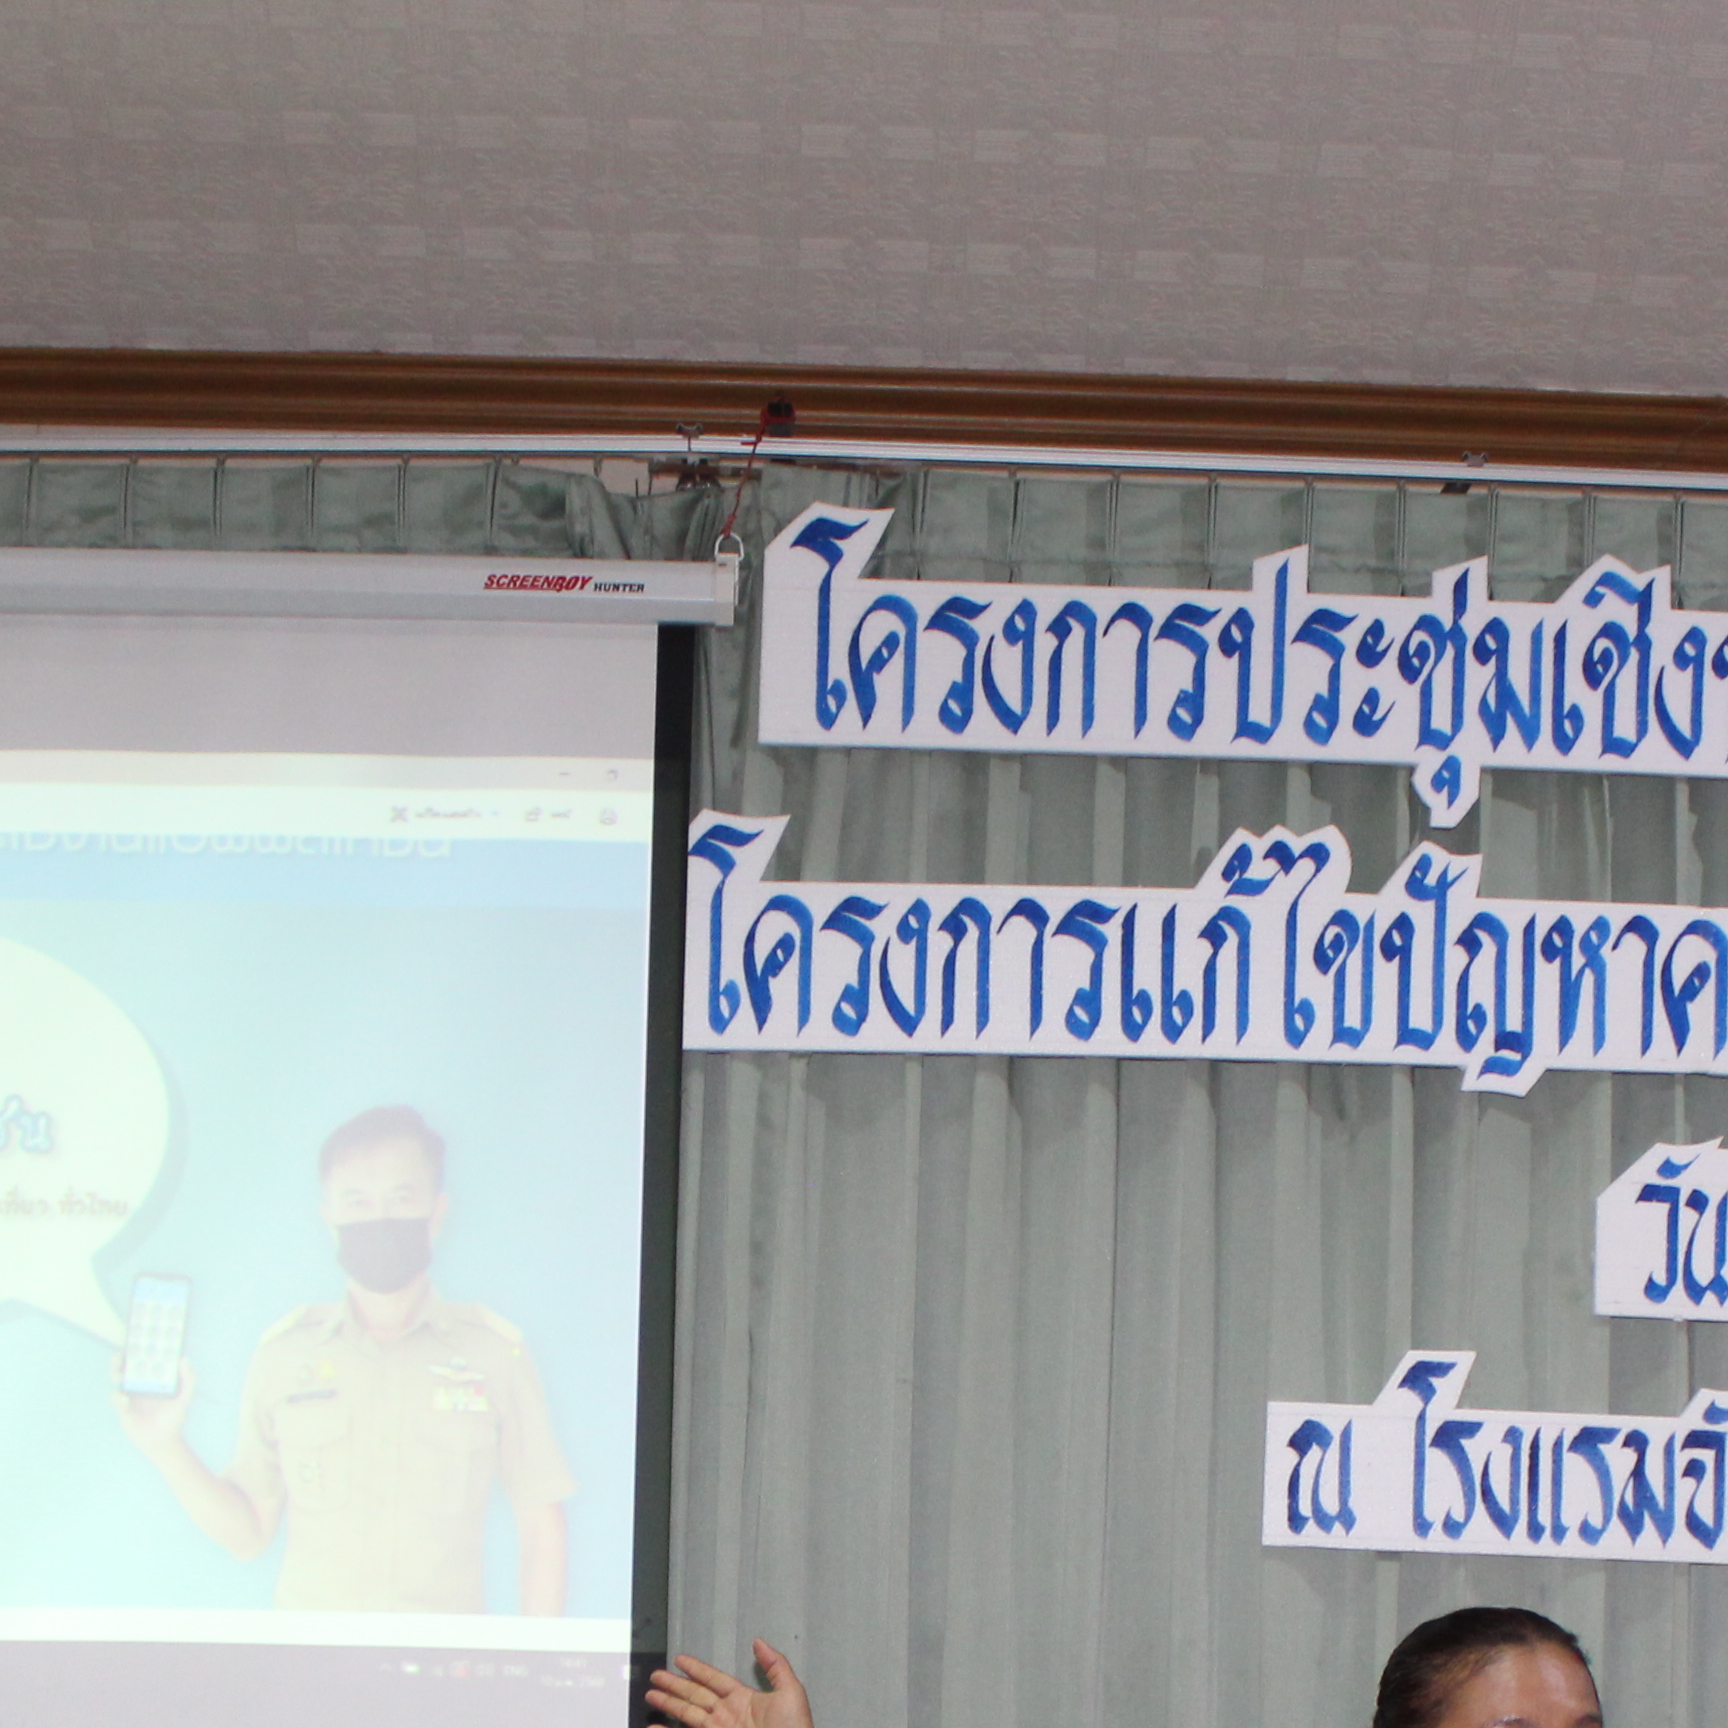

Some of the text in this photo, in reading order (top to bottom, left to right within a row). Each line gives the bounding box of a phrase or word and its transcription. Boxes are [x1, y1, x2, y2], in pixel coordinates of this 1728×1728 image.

[483, 574, 645, 593] SCREENBOY HUNTER
[1286, 1418, 1358, 1535] ณ
